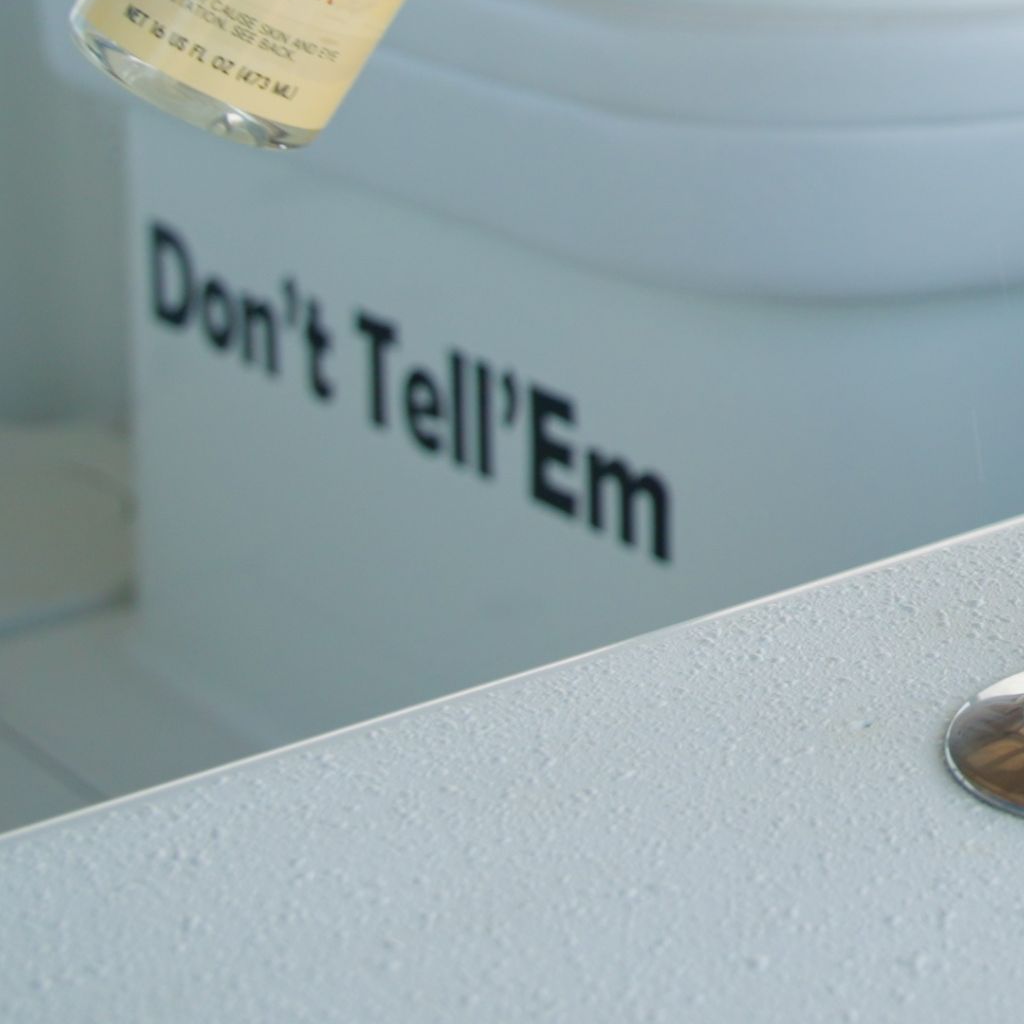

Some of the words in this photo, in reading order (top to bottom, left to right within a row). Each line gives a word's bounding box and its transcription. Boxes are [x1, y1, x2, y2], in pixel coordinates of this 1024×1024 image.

[125, 3, 150, 28] NET
[150, 19, 166, 40] 16
[168, 31, 190, 53] US
[189, 43, 208, 64] FL
[211, 55, 235, 77] OZ
[235, 65, 271, 91] (473
[150, 220, 335, 402] Don't
